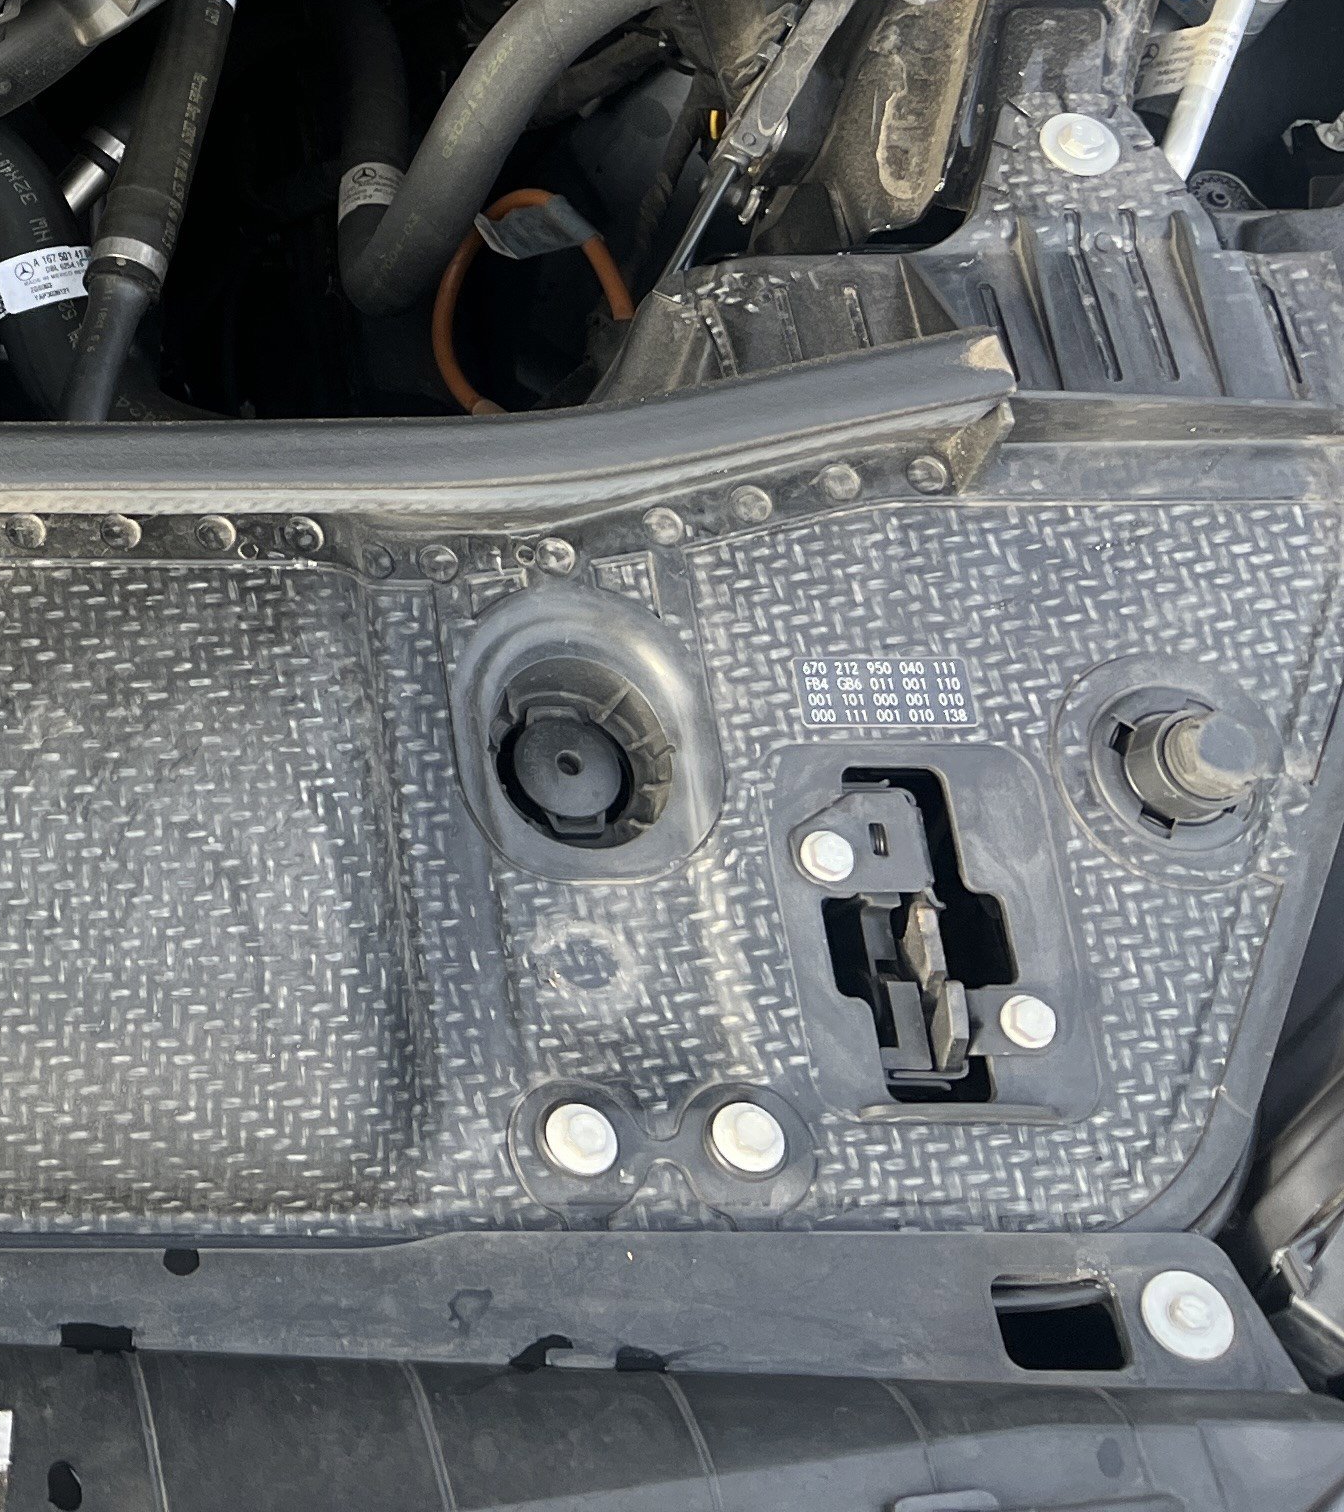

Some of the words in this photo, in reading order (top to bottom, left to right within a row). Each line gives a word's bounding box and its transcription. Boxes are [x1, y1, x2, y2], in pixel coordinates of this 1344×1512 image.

[803, 662, 827, 675] 670
[834, 662, 859, 675] 212
[867, 662, 892, 675] 950
[899, 662, 924, 675] 040
[933, 662, 956, 675] 111
[805, 677, 828, 690] FB4
[837, 677, 862, 690] GB6
[870, 678, 894, 690] 011
[902, 678, 926, 690] 001
[937, 678, 960, 690] 110
[808, 693, 832, 706] 001
[842, 693, 864, 706] 101
[873, 693, 898, 706] 000
[906, 693, 930, 706] 001
[938, 693, 964, 706] 010
[811, 709, 836, 722] 000
[845, 709, 868, 722] 111
[876, 709, 900, 722] 001
[909, 709, 934, 722] 010
[943, 709, 967, 722] 138
